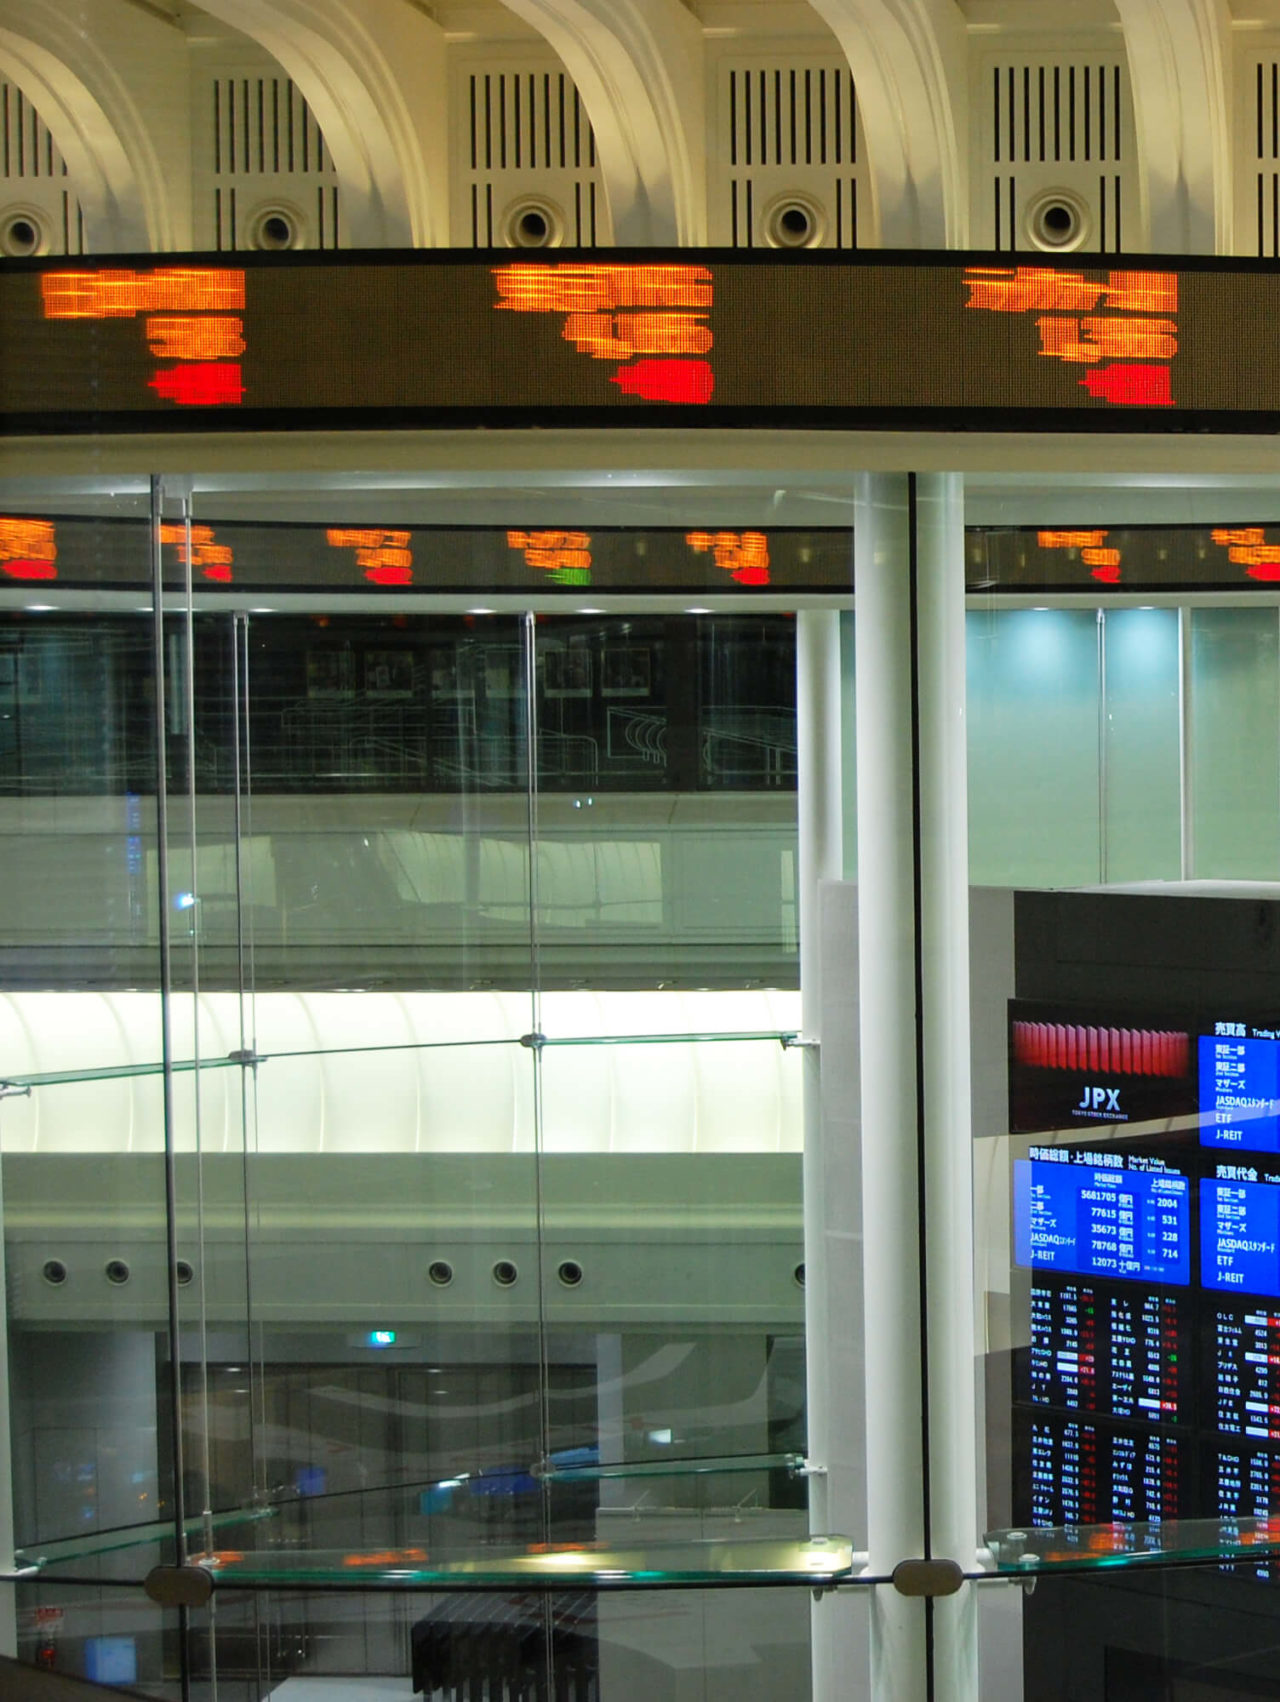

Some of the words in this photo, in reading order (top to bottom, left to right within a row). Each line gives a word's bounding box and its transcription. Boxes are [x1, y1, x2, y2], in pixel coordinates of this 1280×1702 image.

[1252, 1028, 1274, 1040] Trading
[1215, 1079, 1245, 1089] マザーズ
[1079, 1086, 1120, 1111] JPX
[1216, 1114, 1232, 1123] ETF
[1216, 1130, 1242, 1141] J-REIT
[1129, 1155, 1148, 1164] Market
[1081, 1190, 1116, 1202] 5681705
[1157, 1198, 1177, 1208] 2004
[1091, 1208, 1116, 1218] 77615
[1162, 1215, 1177, 1225] 531
[1217, 1222, 1246, 1232] マザーズ
[1091, 1224, 1116, 1234] 35673
[1162, 1232, 1178, 1242] 228
[1092, 1241, 1117, 1251] 78768
[1163, 1249, 1178, 1258] 714
[1030, 1250, 1055, 1261] J-REIT
[1092, 1257, 1117, 1268] 12073
[1217, 1256, 1233, 1266] ETF
[1218, 1272, 1244, 1283] J-REIT
